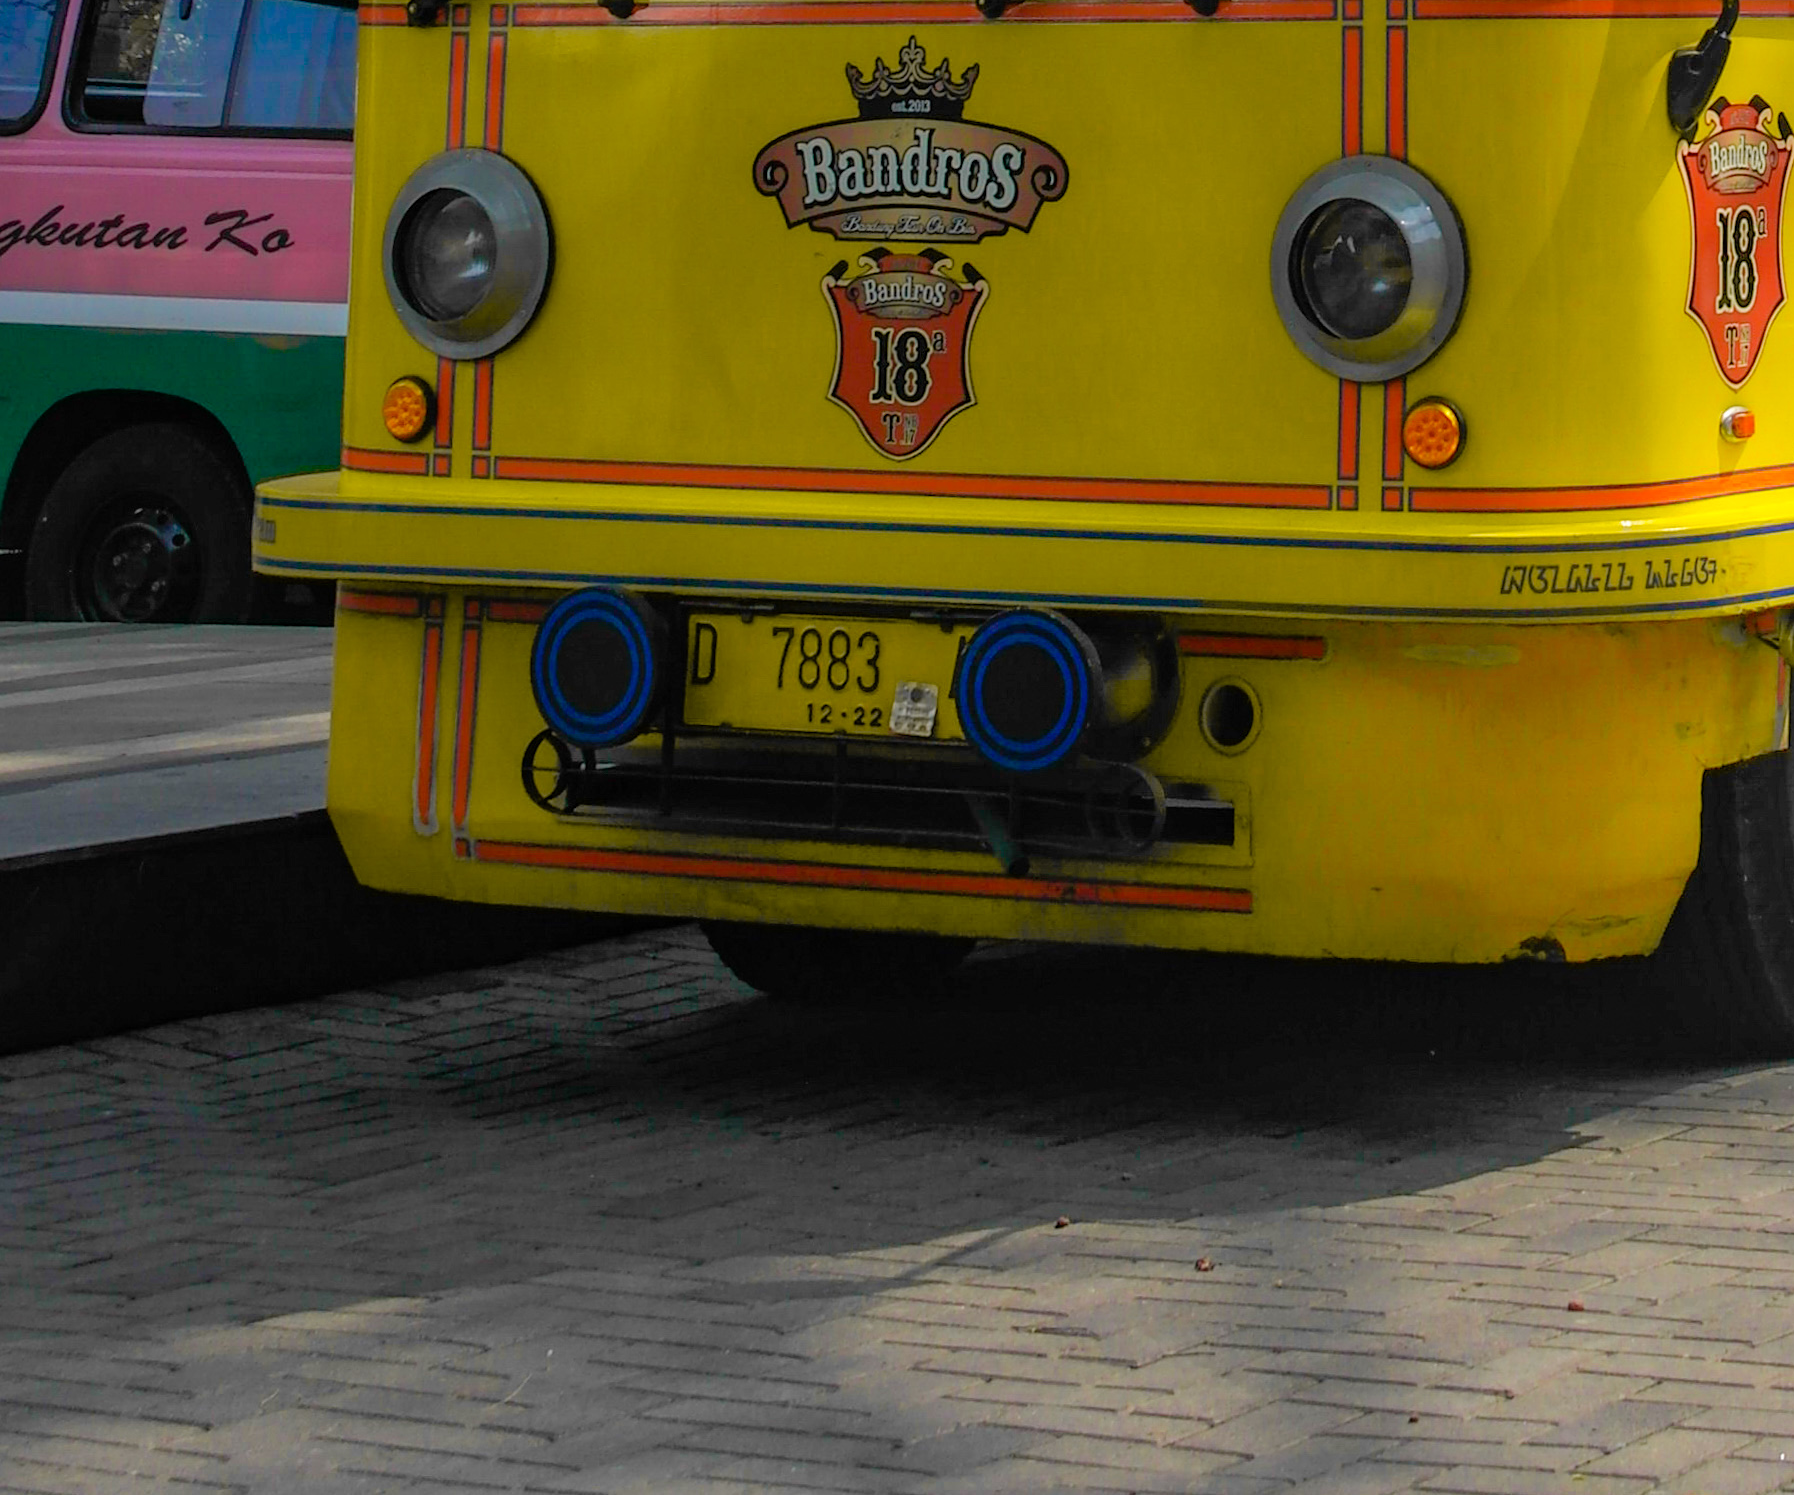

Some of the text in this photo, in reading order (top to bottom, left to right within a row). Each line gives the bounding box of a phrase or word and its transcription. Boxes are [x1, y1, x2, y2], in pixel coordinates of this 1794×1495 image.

[796, 128, 1026, 210] Bandros
[1708, 133, 1768, 179] Bandros
[204, 208, 295, 257] Ko
[862, 275, 947, 307] Bandros
[690, 622, 718, 685] D
[772, 625, 881, 693] 7883
